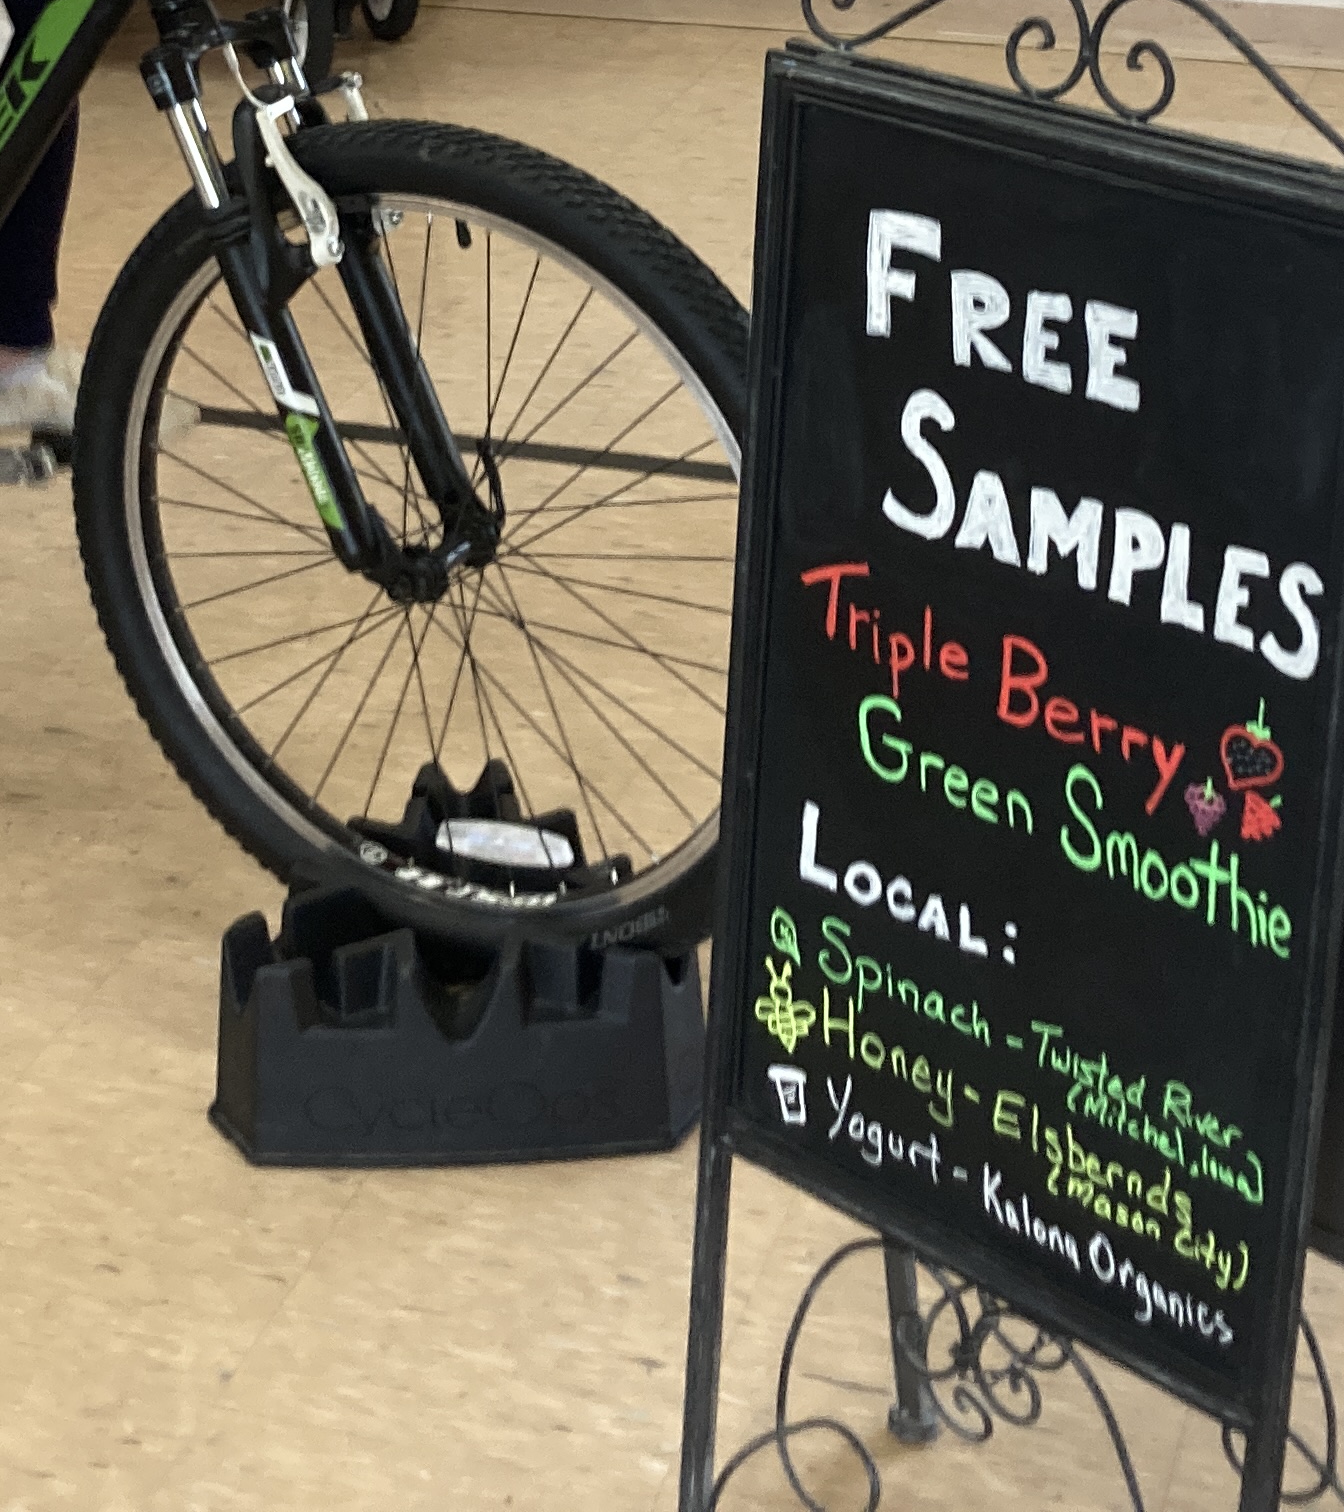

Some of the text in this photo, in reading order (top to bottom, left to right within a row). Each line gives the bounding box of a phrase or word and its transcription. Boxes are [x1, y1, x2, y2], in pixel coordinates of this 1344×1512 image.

[866, 208, 1141, 412] FREE
[881, 388, 1324, 680] SAMPLES
[801, 562, 1185, 816] Triple Berry
[798, 799, 1016, 965] LOCAL:
[859, 694, 1291, 959] Green Smoothie
[818, 915, 991, 1047] Spinach
[1030, 1019, 1147, 1110] Twisted
[1163, 1079, 1244, 1149] River
[822, 985, 954, 1129] Honey
[993, 1088, 1194, 1231] Elsbernds
[827, 1073, 942, 1185] Yogurt
[983, 1161, 1081, 1272] Kalona
[1089, 1230, 1234, 1346] Organics
